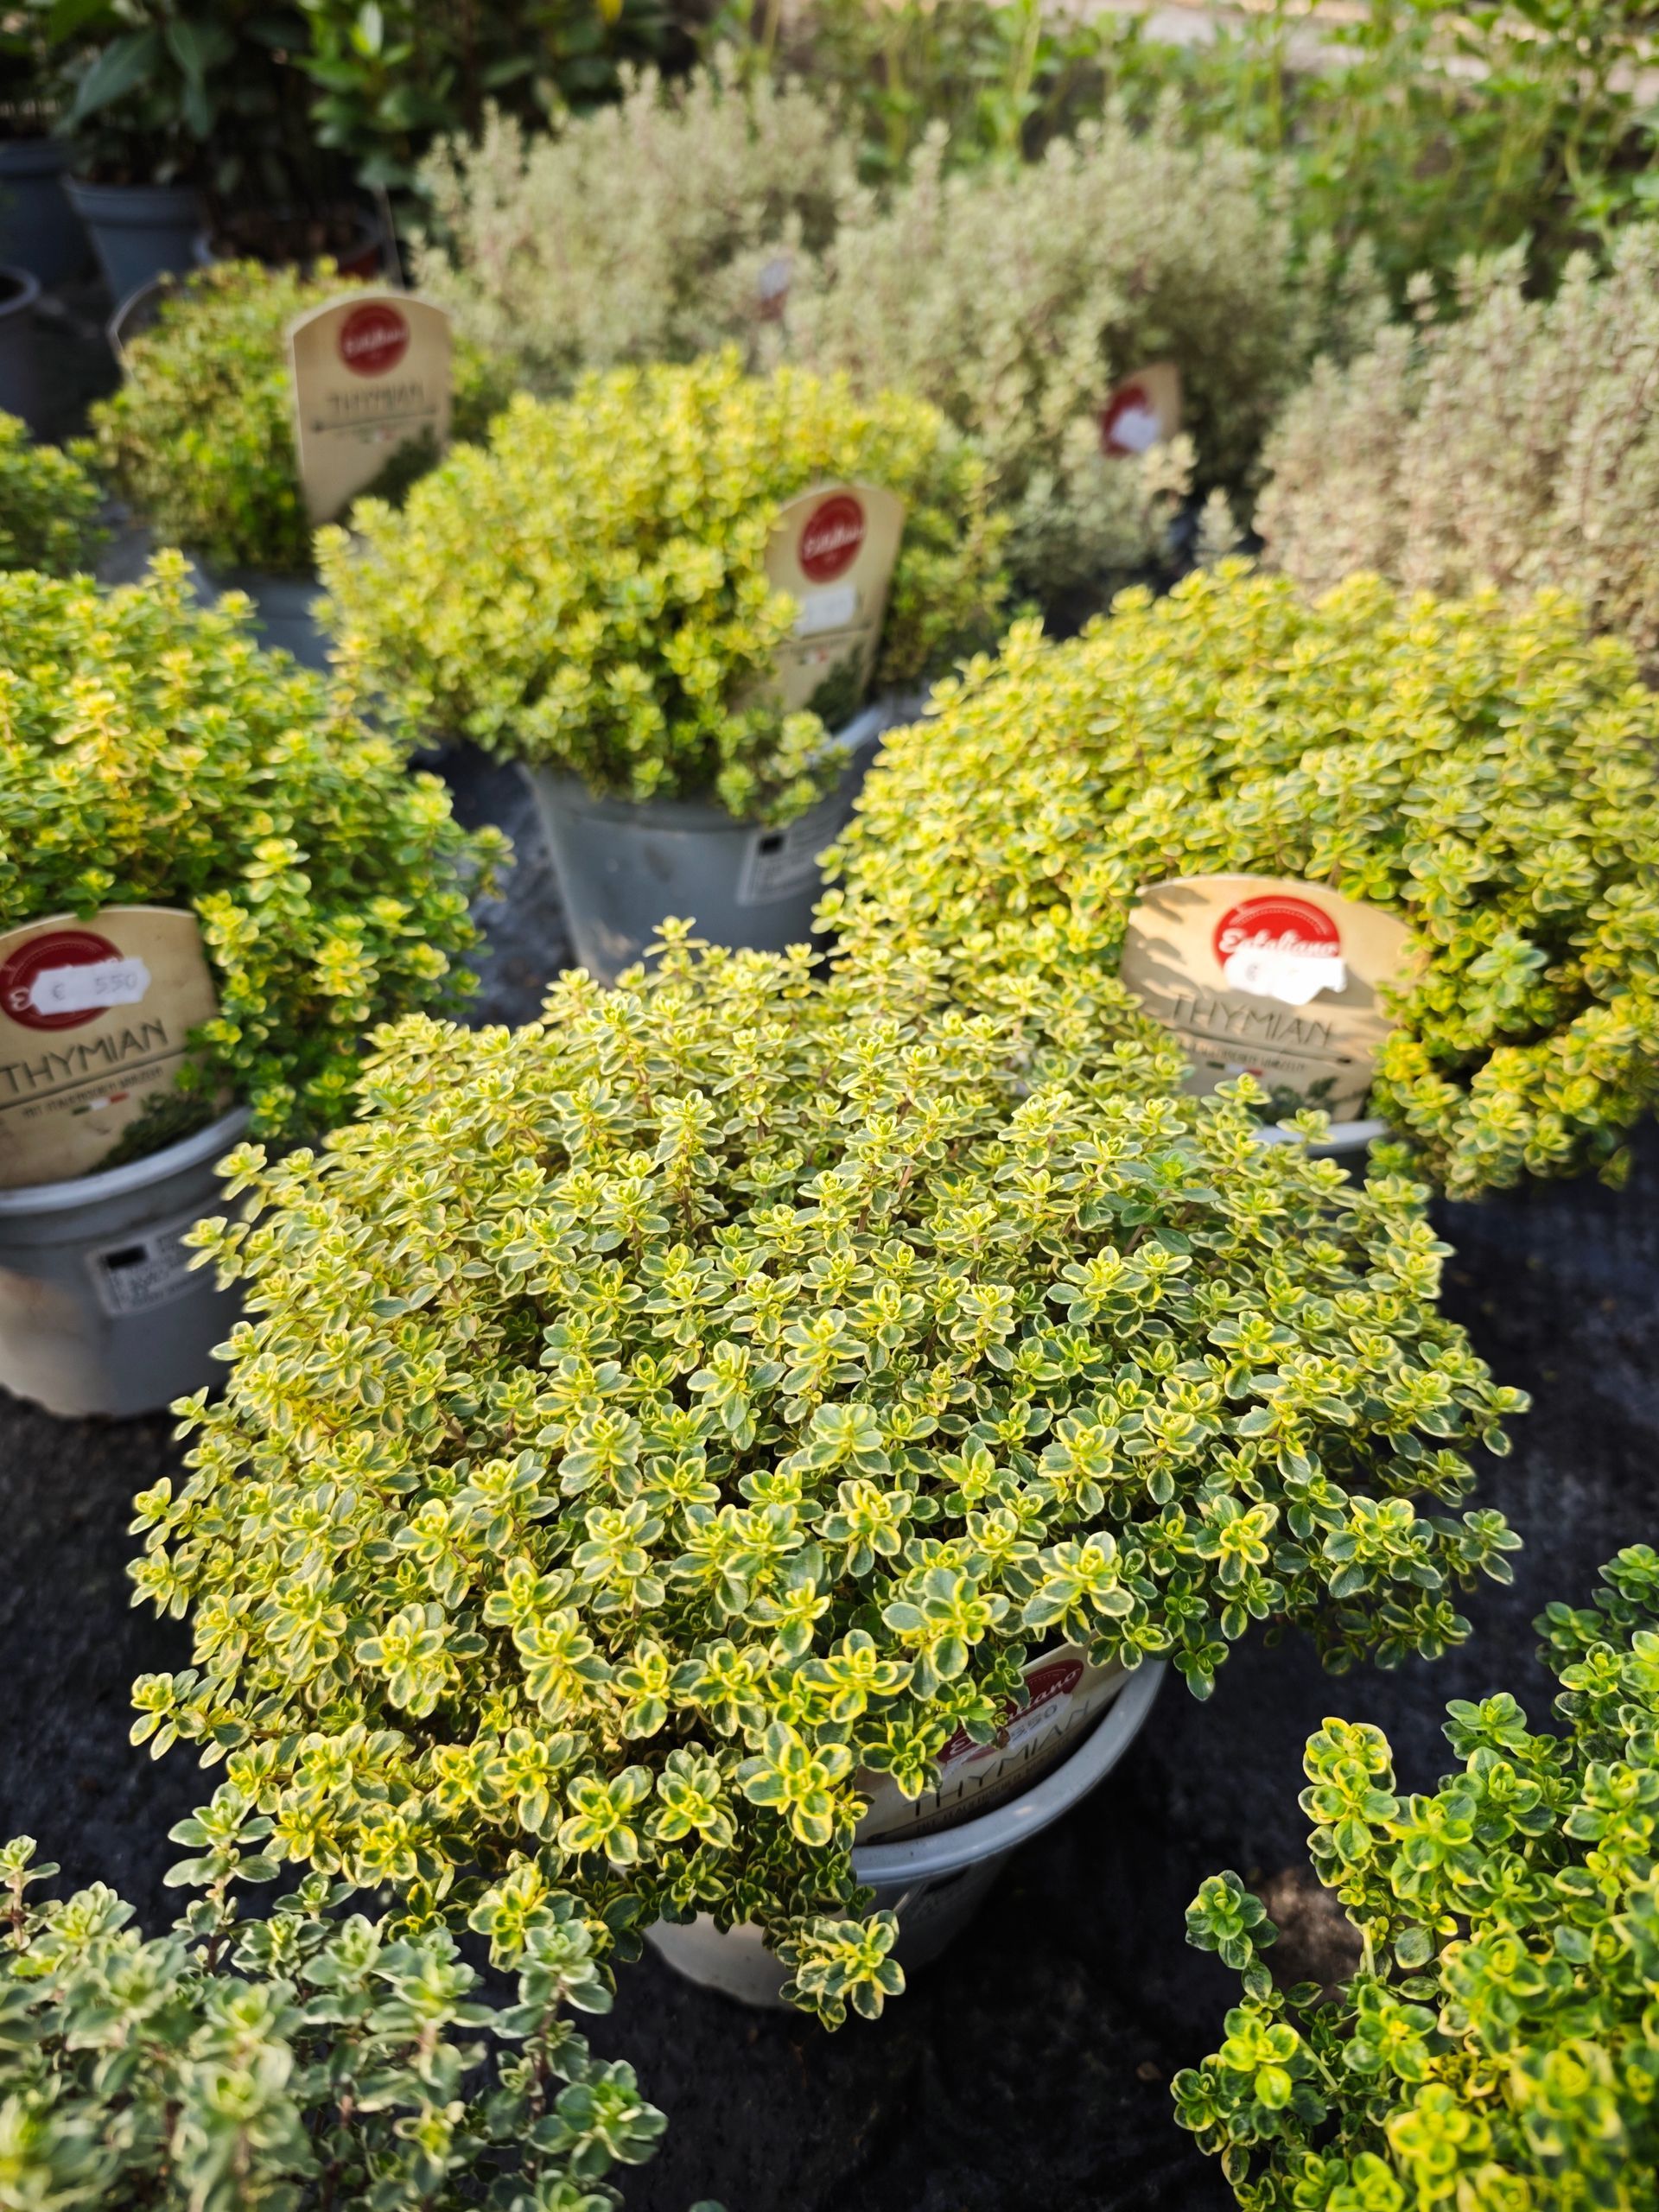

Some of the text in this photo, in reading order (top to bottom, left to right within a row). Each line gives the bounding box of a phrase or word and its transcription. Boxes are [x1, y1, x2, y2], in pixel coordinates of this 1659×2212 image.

[0, 1018, 168, 1093] THYMIAN
[1172, 995, 1332, 1047] THYMIAN
[903, 1700, 1089, 1816] THYMIAN
